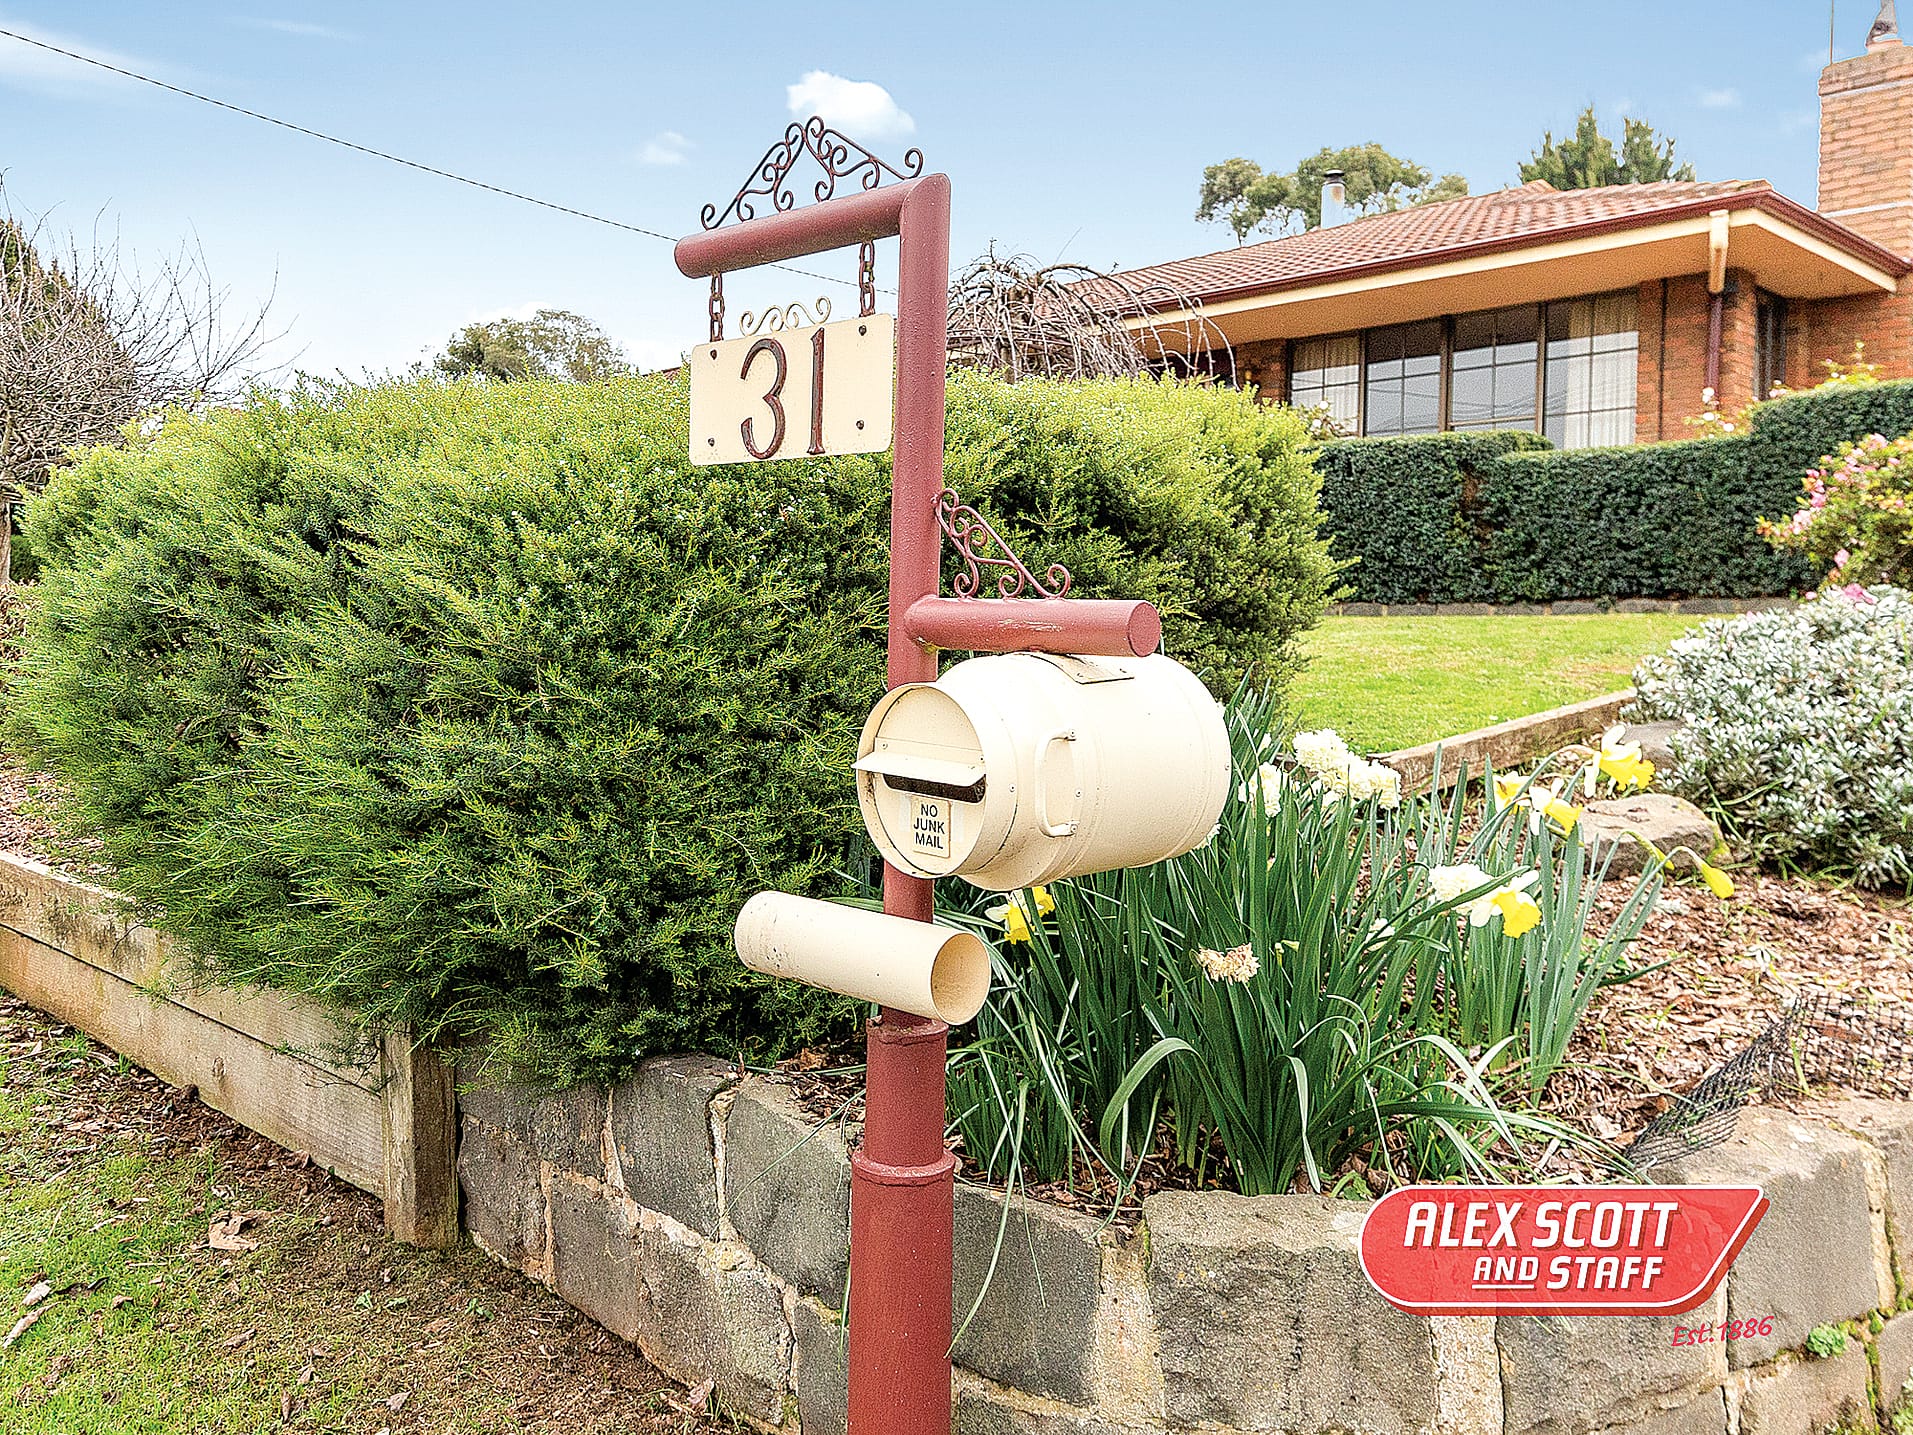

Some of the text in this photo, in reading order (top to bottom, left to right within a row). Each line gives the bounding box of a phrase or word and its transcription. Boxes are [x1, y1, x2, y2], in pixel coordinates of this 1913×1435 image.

[740, 327, 825, 459] 31
[921, 804, 938, 817] NO
[913, 817, 945, 835] JUNK
[915, 832, 943, 849] MAIL
